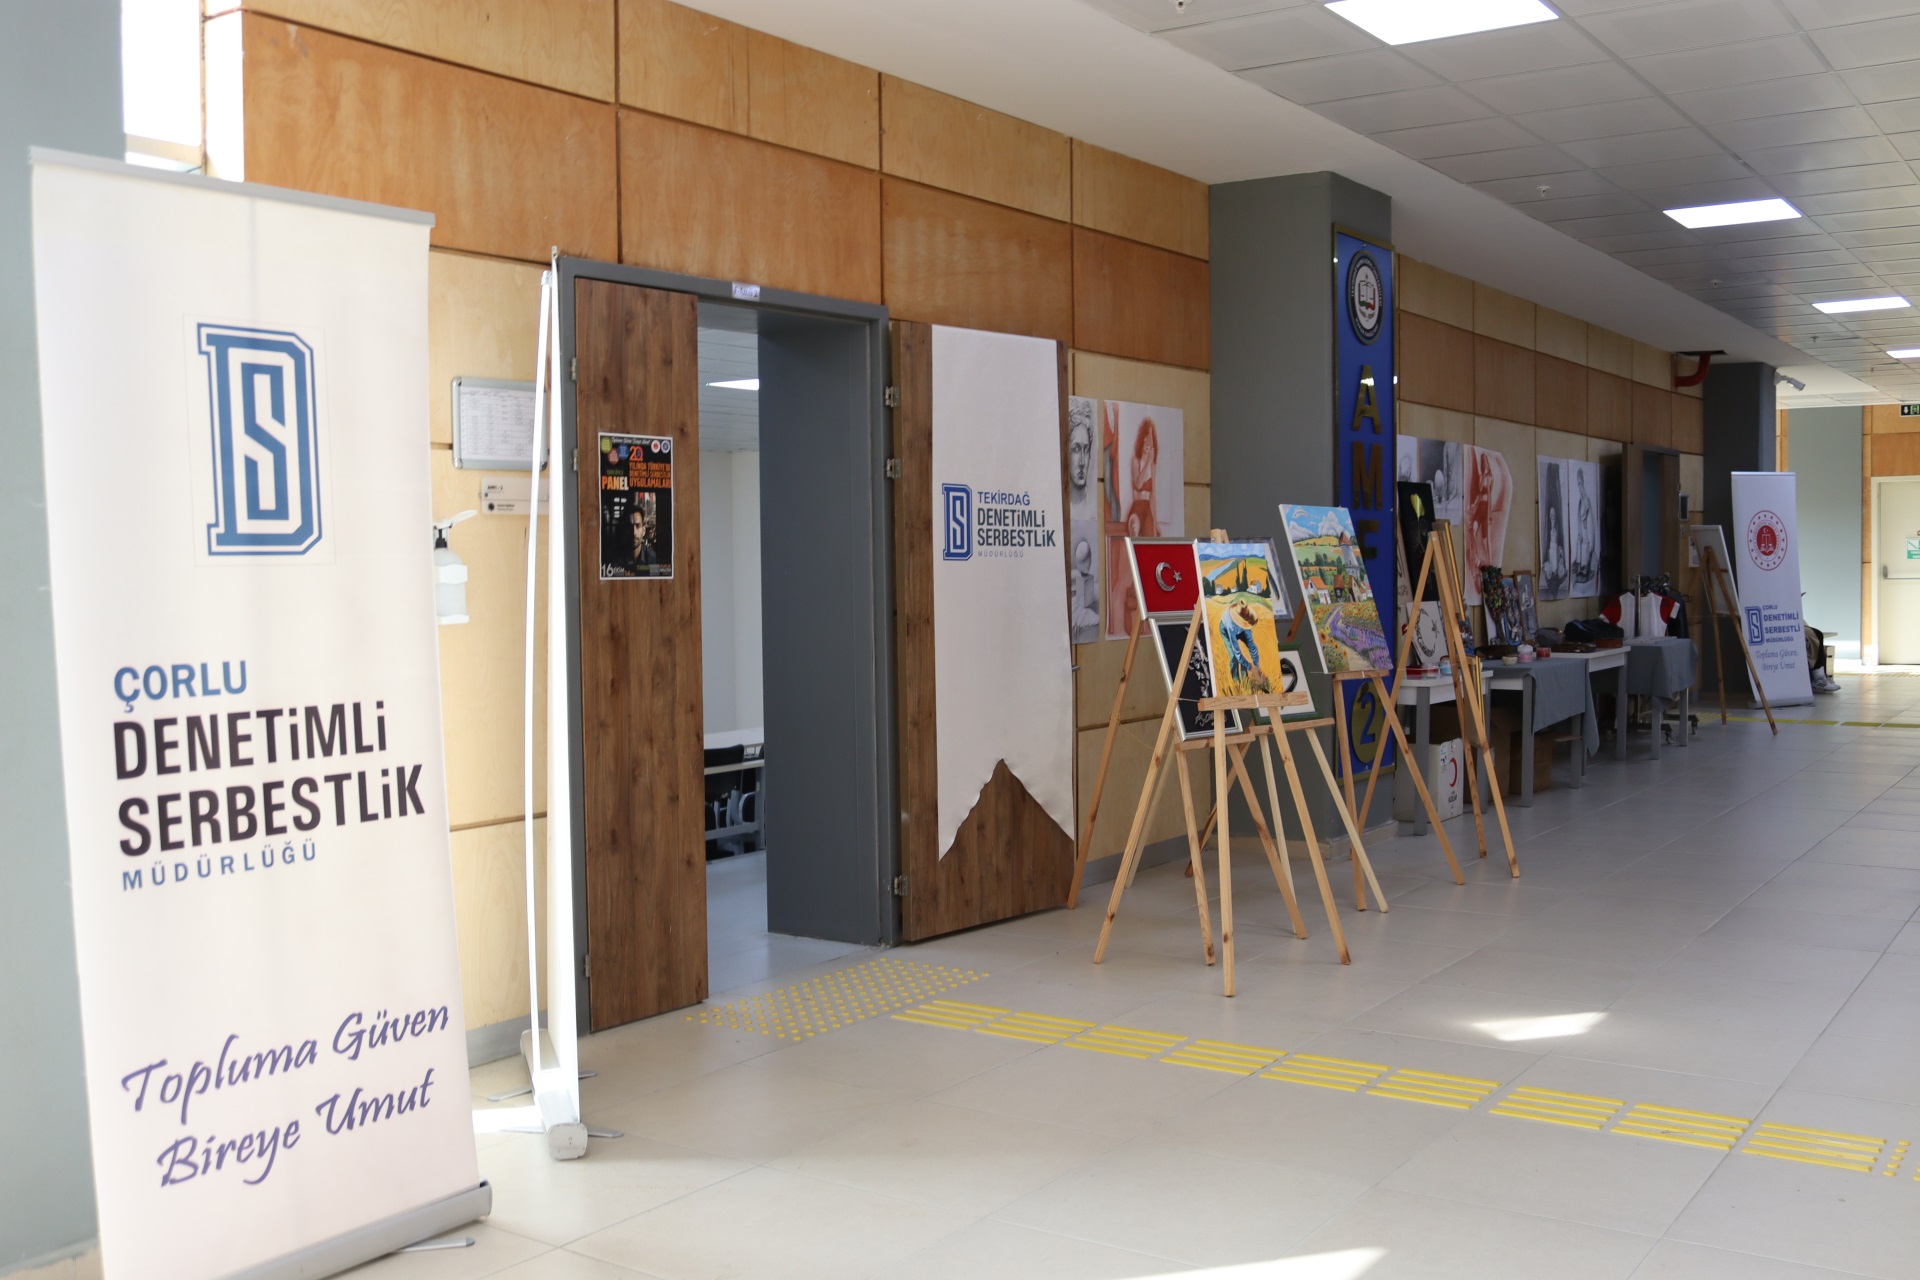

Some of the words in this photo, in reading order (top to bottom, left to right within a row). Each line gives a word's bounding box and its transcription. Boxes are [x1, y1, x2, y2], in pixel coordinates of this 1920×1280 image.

[602, 476, 629, 491] PANEL
[977, 490, 1031, 506] TEKİRDAĞ
[601, 563, 613, 577] 16
[978, 550, 1024, 558] MÜDÜRLÜĞÜ
[1763, 611, 1799, 622] DENETİMLİ
[113, 660, 249, 713] ÇORLU
[1359, 691, 1376, 745] 2
[122, 841, 318, 892] MÜDÜRLÜĞÜ
[121, 1033, 320, 1127] Topluma
[331, 1004, 451, 1061] Güven
[156, 1117, 302, 1188] Bireye
[315, 1067, 437, 1138] Umut
